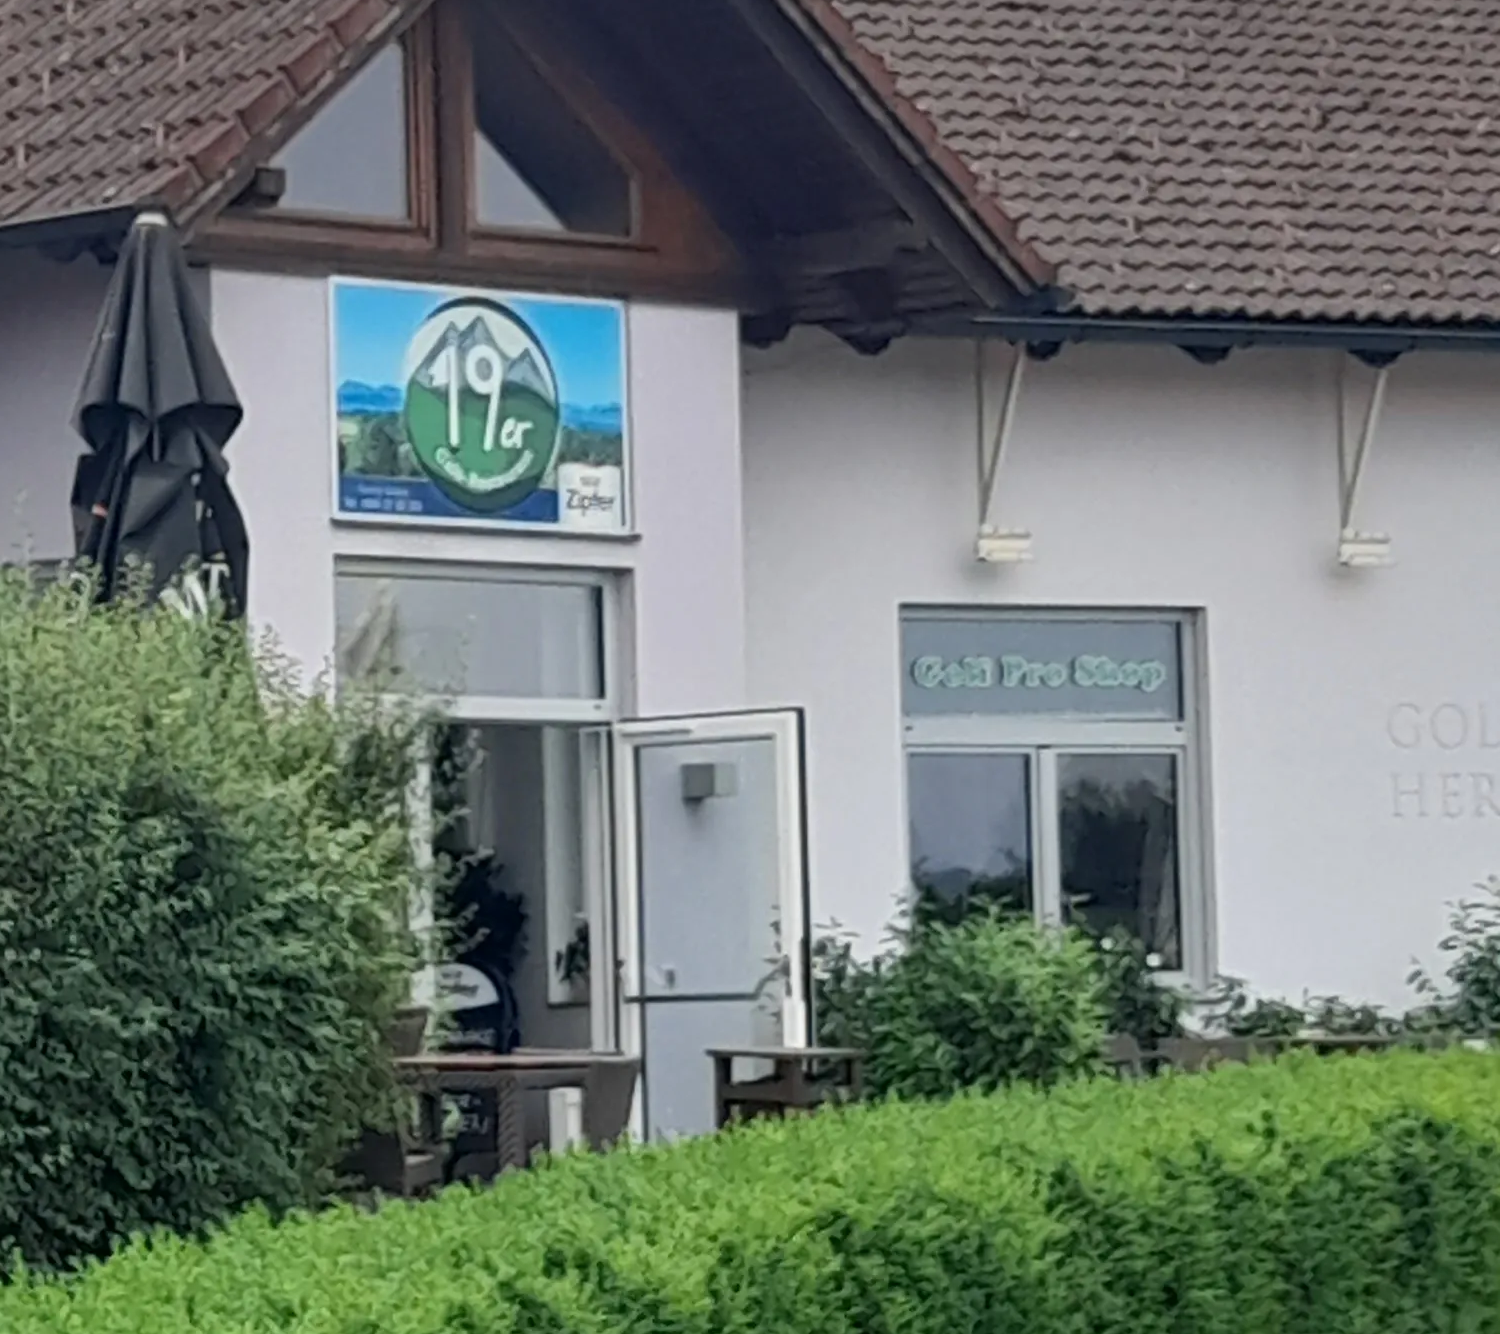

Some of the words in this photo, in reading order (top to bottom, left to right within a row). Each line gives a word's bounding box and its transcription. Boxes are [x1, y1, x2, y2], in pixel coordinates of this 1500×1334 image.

[1000, 655, 1067, 688] Pro
[1073, 654, 1166, 692] Shop
[1390, 771, 1500, 818] HER
